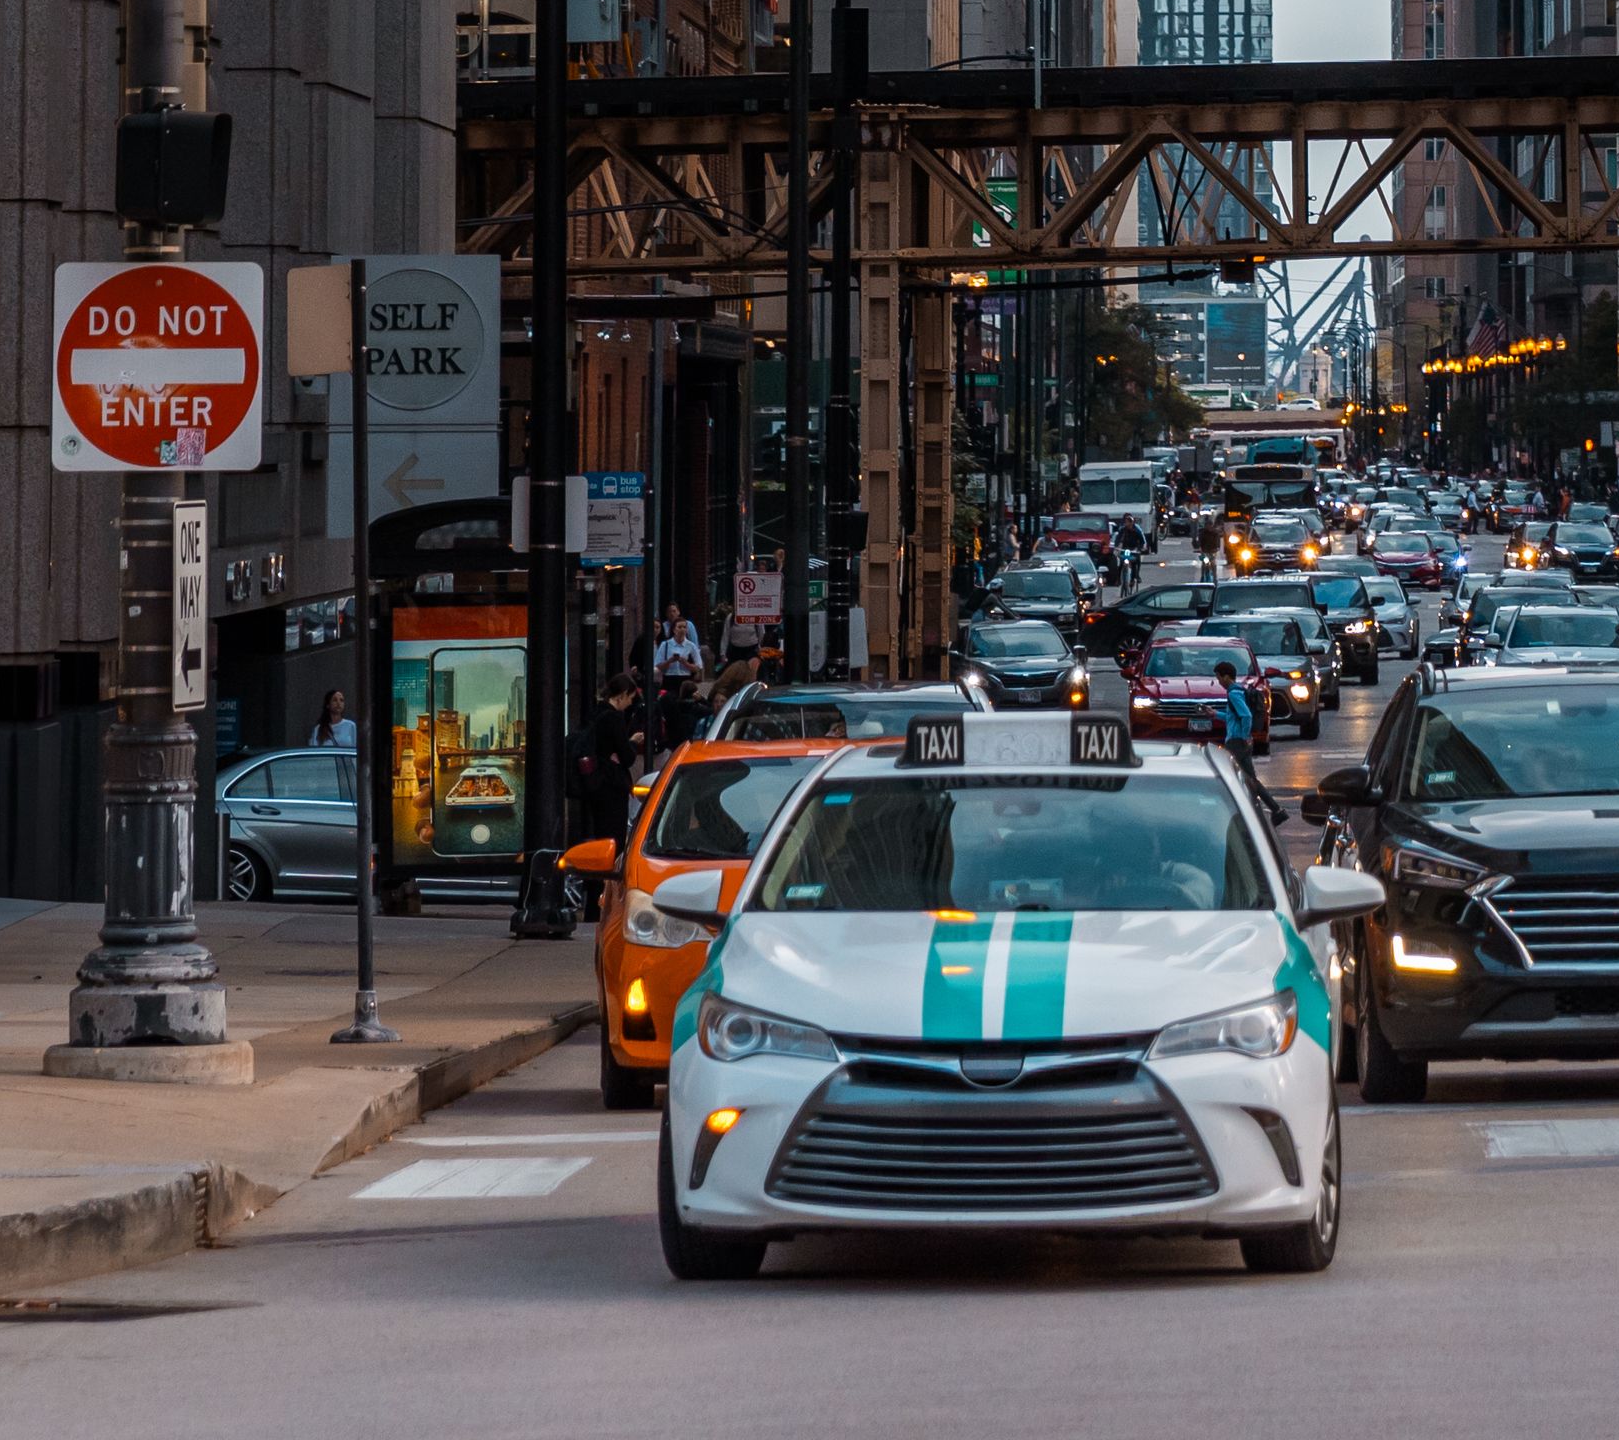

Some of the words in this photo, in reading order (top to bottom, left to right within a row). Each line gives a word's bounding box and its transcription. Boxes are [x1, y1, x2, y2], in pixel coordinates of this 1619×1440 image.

[89, 306, 136, 337] DO
[158, 305, 229, 337] NOT
[369, 303, 460, 332] SELF
[366, 347, 466, 375] PARK
[101, 396, 213, 428] ENTER
[620, 476, 637, 485] bus
[620, 486, 641, 496] stop
[181, 521, 200, 565] ONE
[180, 575, 201, 619] WAY
[917, 725, 959, 760] TAXI
[1077, 725, 1119, 760] TAXI
